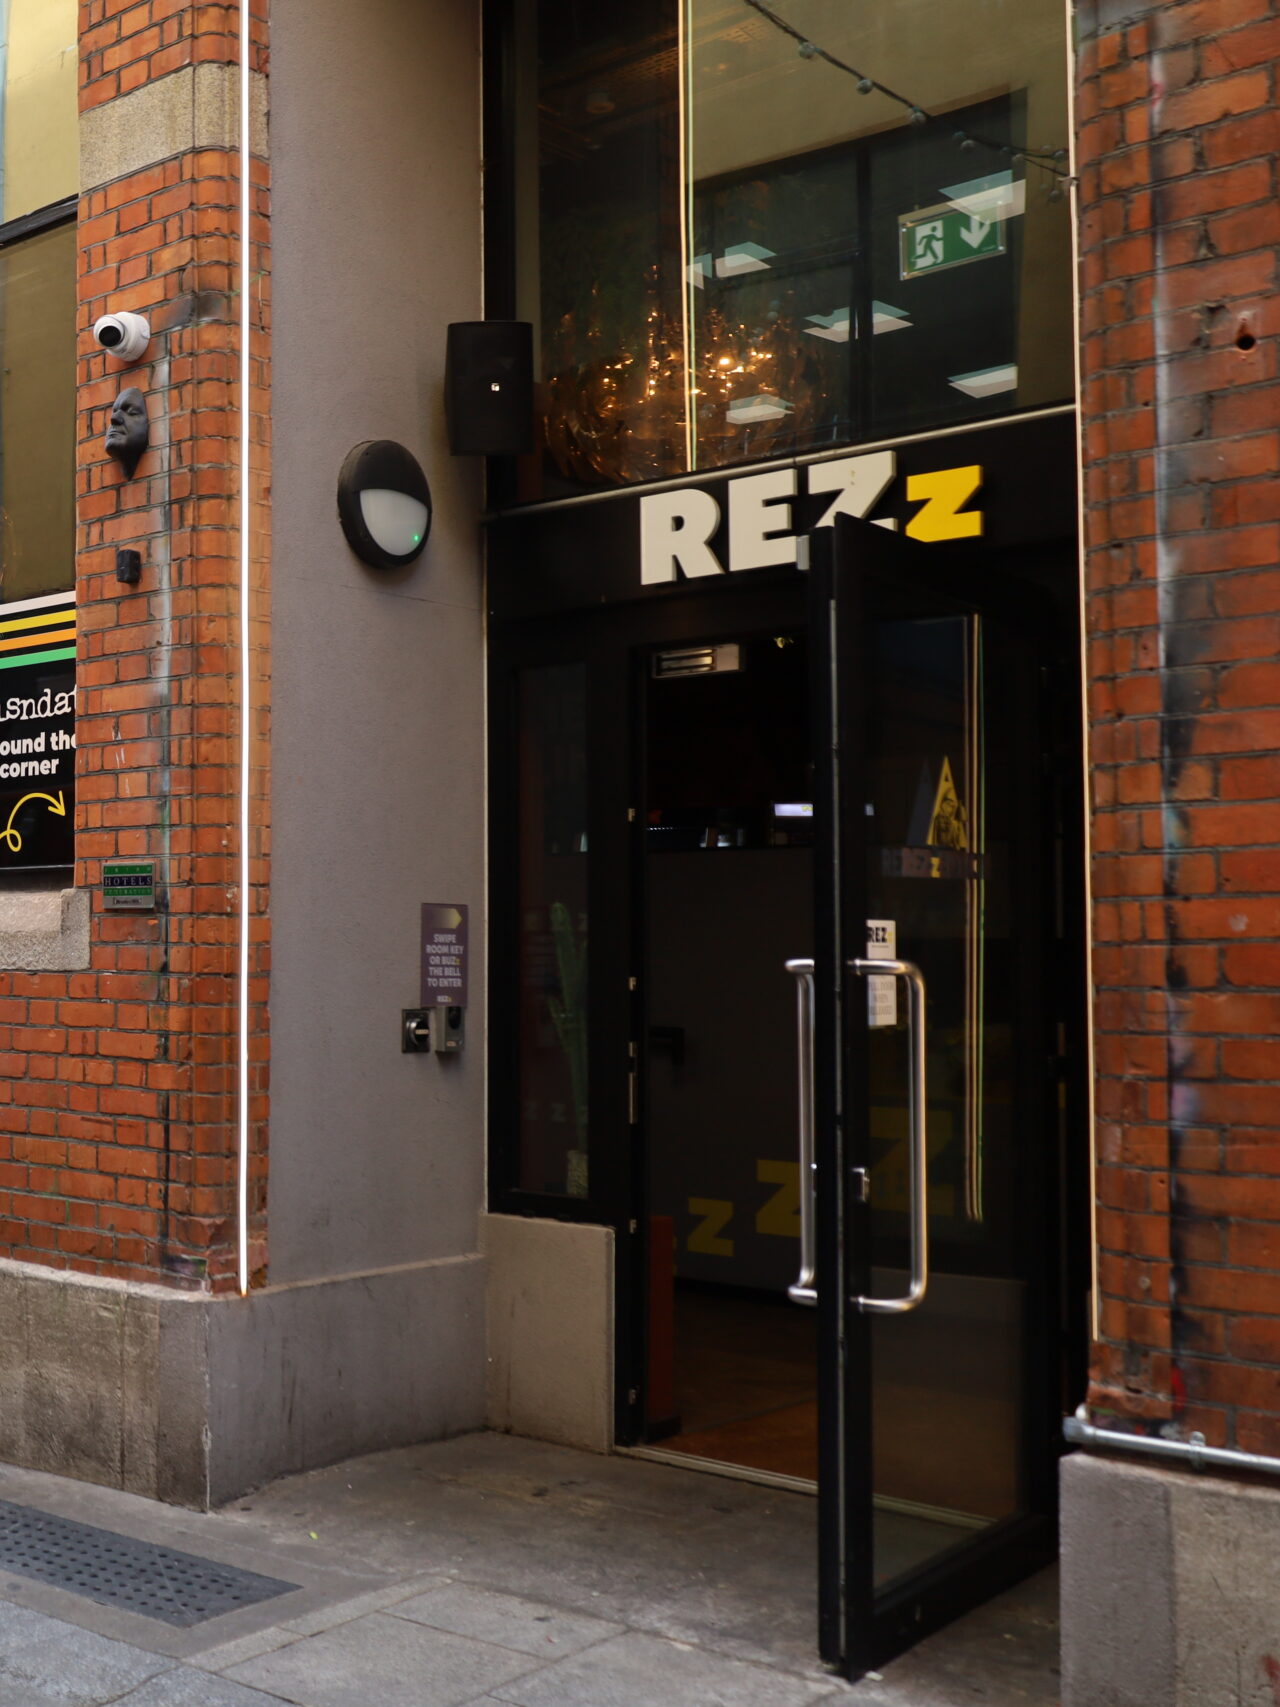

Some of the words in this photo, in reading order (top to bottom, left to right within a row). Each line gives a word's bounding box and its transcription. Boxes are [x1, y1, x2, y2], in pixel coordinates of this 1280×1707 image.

[0, 758, 60, 779] corner
[104, 876, 152, 886] HOTELS
[433, 933, 457, 944] SWIPE
[426, 944, 449, 954] ROOM
[450, 945, 464, 955] KEY
[429, 955, 441, 965] OR
[428, 966, 443, 976] THE
[444, 967, 462, 977] BELL
[427, 977, 438, 987] TO
[439, 978, 463, 988] ENTER
